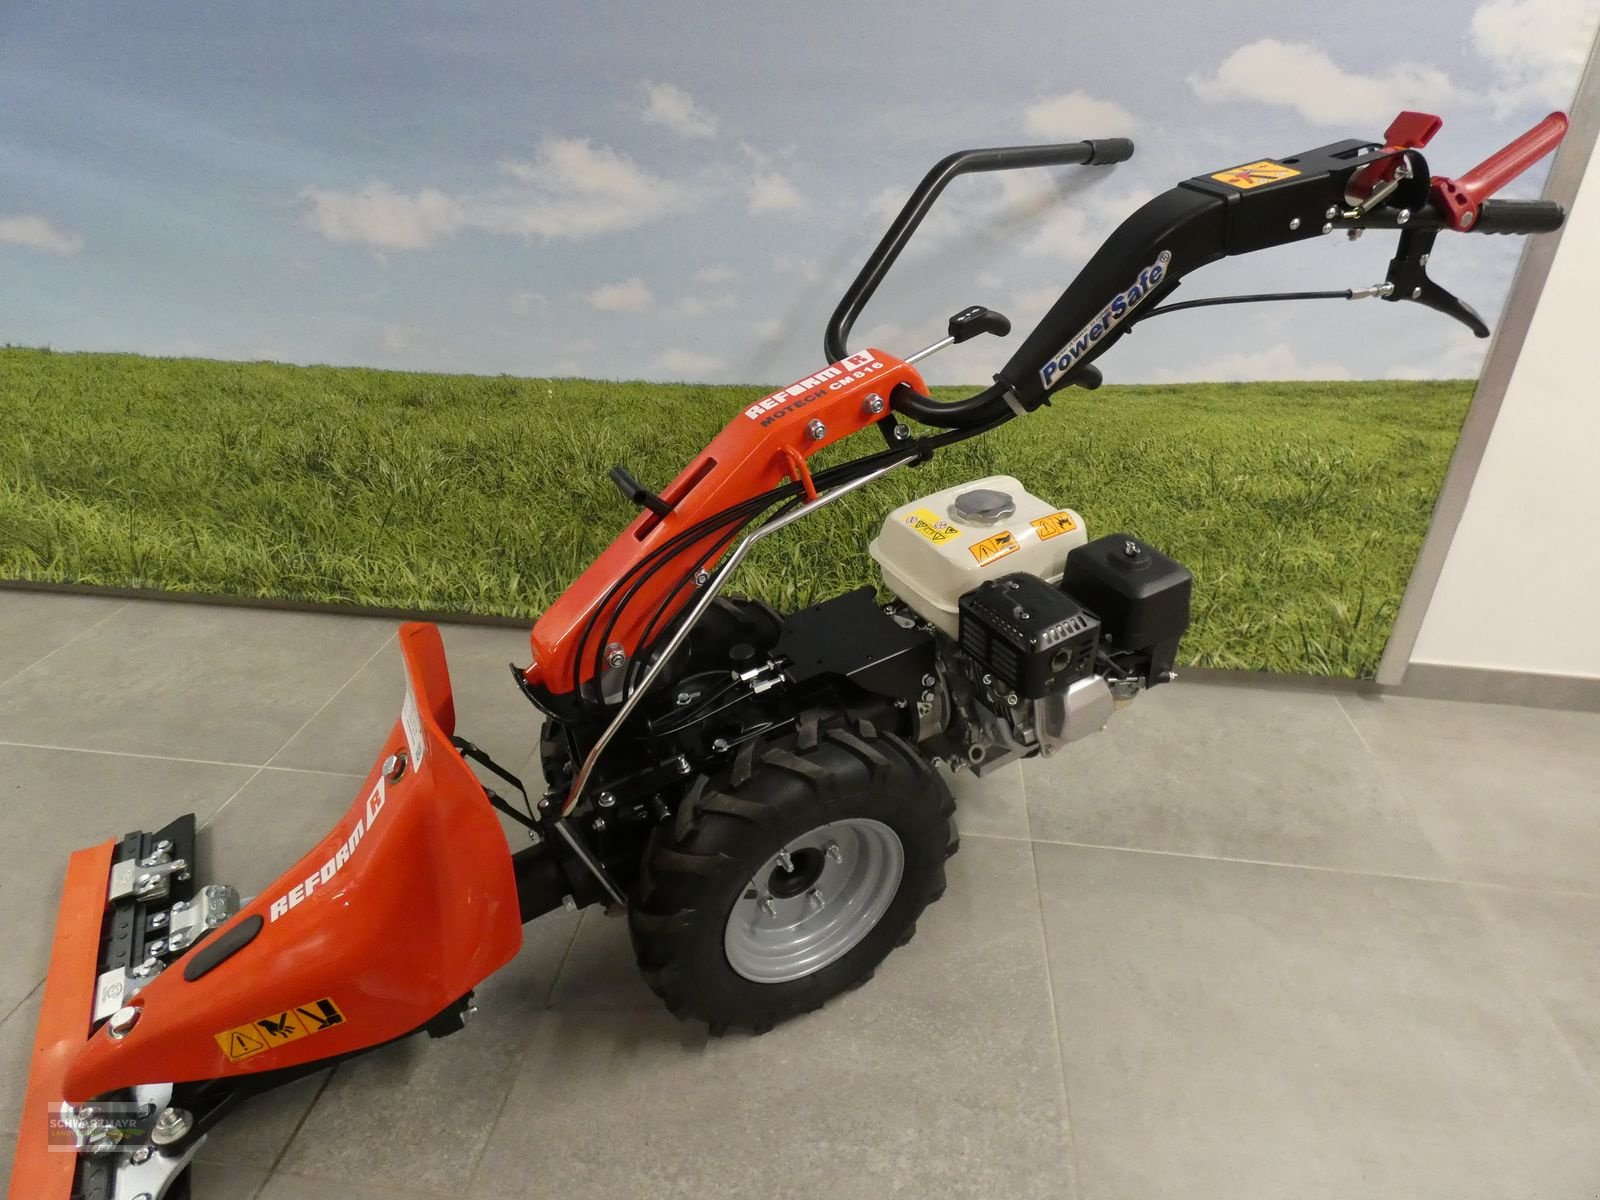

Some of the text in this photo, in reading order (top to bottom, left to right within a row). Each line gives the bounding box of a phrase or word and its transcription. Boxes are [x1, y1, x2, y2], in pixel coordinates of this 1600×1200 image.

[744, 366, 843, 420] REFORM
[760, 389, 828, 427] MOTECH
[269, 819, 365, 924] REFORM
